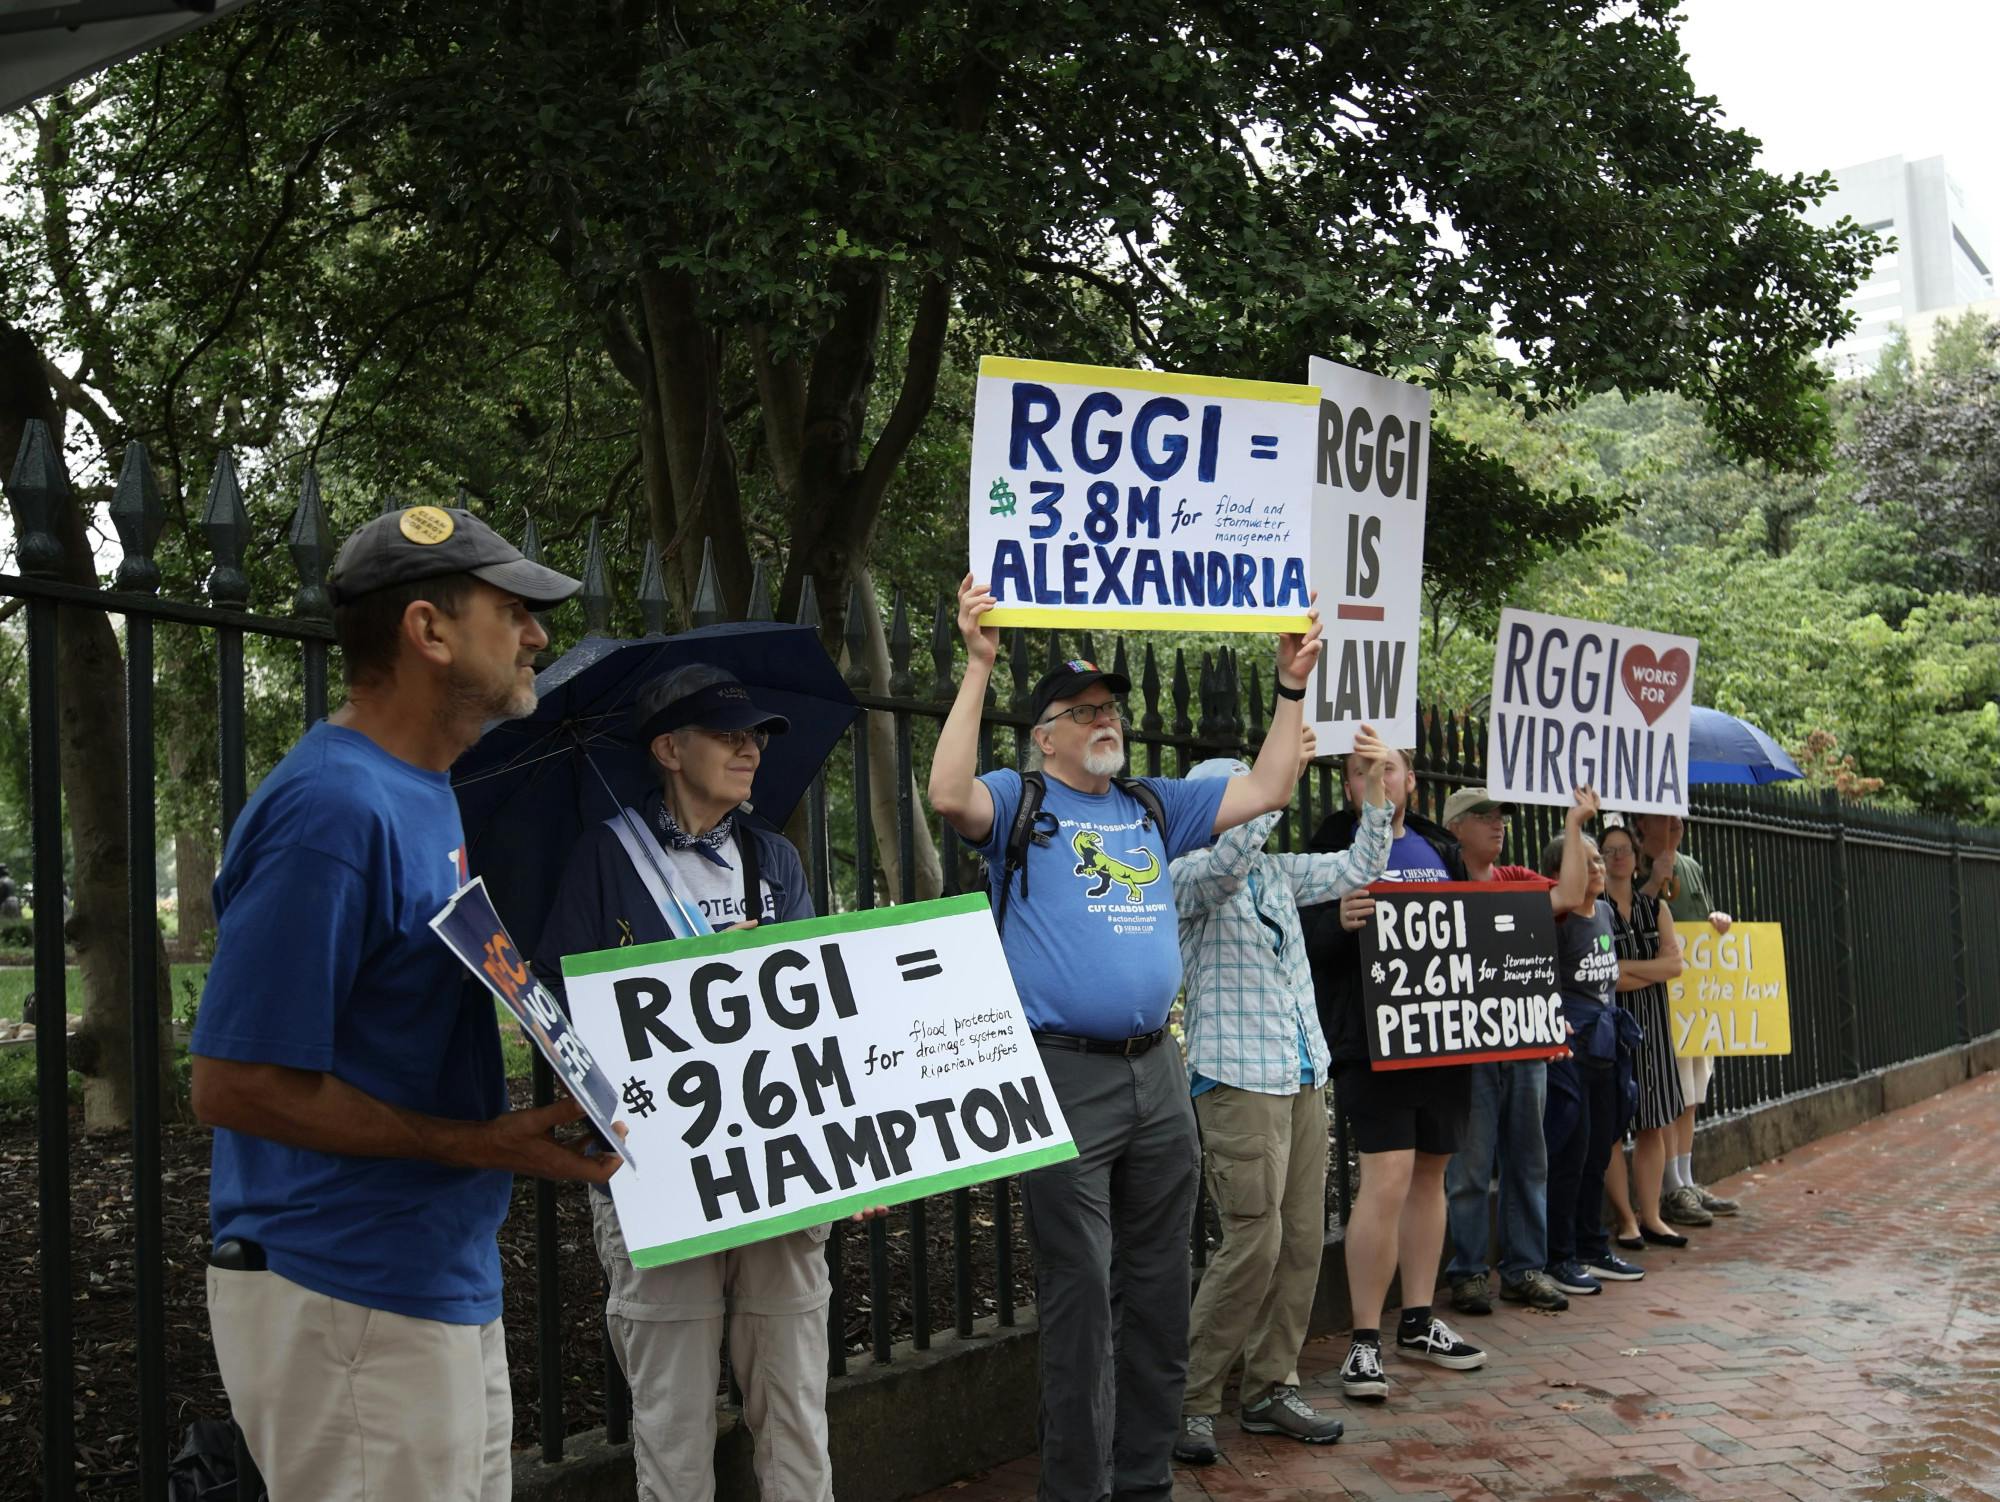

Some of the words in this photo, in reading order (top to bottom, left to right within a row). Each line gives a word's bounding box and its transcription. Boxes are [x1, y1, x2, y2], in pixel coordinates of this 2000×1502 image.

[1009, 382, 1222, 482] RGGI
[1317, 399, 1421, 500] RGGI
[1171, 499, 1203, 533] for
[1216, 495, 1255, 515] flood
[1264, 502, 1285, 515] and
[1216, 517, 1286, 530] stormwater
[1216, 530, 1290, 547] management
[991, 539, 1311, 608] ALEXANDRIA
[1346, 514, 1381, 599] IS
[1316, 638, 1406, 722] LAW
[1502, 622, 1620, 716] RGGI
[1632, 666, 1678, 686] WORKS
[1640, 687, 1667, 704] FOR
[1498, 712, 1682, 805] VIRGINIA
[1088, 904, 1106, 913] CUT
[1108, 904, 1144, 913] CARBON
[1146, 903, 1167, 912] NOW!
[1375, 900, 1468, 951] RGGI
[1478, 958, 1498, 982] for
[1503, 954, 1546, 968] Stormwater
[1503, 970, 1532, 985] Drainage
[1534, 967, 1555, 985] study
[1579, 952, 1616, 969] clean
[613, 943, 859, 1061] RGGI
[1698, 976, 1734, 1000] the
[1744, 976, 1780, 1000] law
[909, 1017, 948, 1041] flood
[954, 1008, 1013, 1032] protection
[1376, 992, 1566, 1057] PETERSBURG
[1675, 1008, 1768, 1051] Y'ALL
[915, 1037, 966, 1059] drainage
[969, 1025, 1014, 1047] systems
[865, 1044, 904, 1076] for
[920, 1056, 975, 1079] Riparian
[978, 1043, 1019, 1067] buffers
[690, 1076, 1053, 1222] HAMPTON
